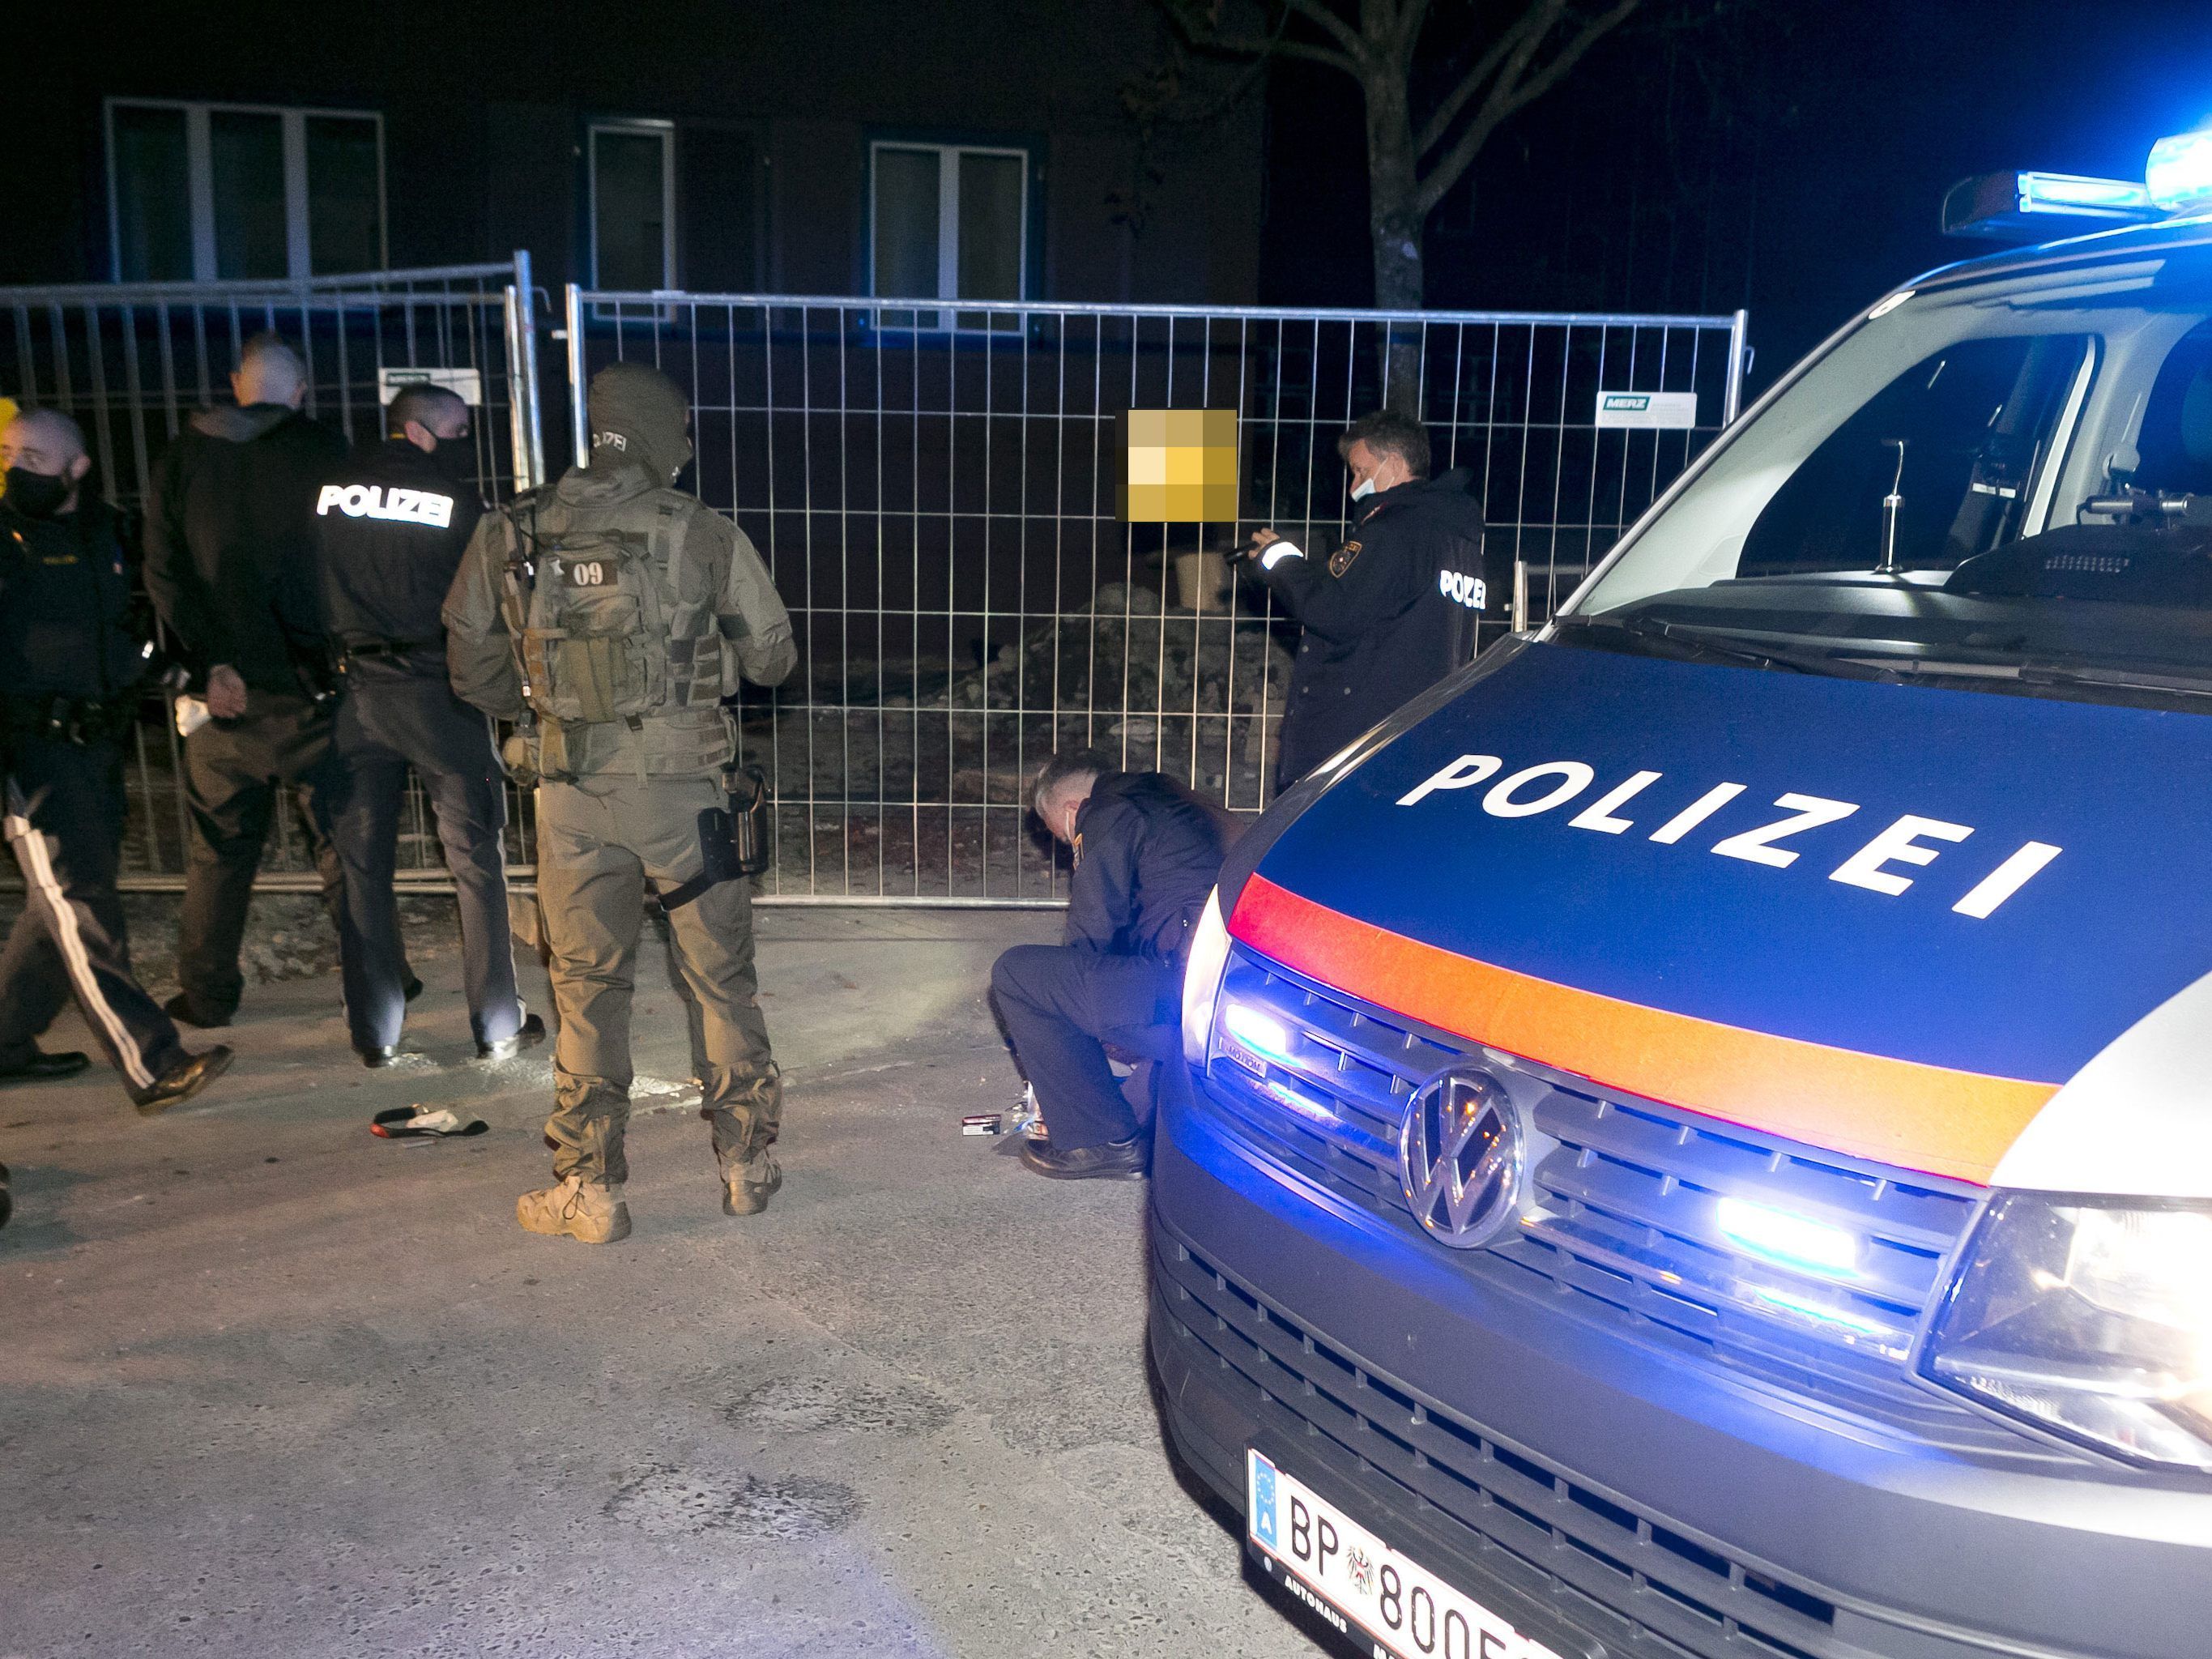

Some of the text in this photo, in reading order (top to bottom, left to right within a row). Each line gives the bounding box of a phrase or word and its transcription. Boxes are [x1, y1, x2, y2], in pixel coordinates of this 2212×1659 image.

[1606, 398, 1647, 409] MERZ
[317, 484, 454, 528] POLIZEI
[573, 561, 603, 586] 09
[1396, 754, 2063, 919] POLIZEI
[1291, 1495, 1339, 1576] BP
[1285, 1575, 1347, 1634] AUTOHAUS
